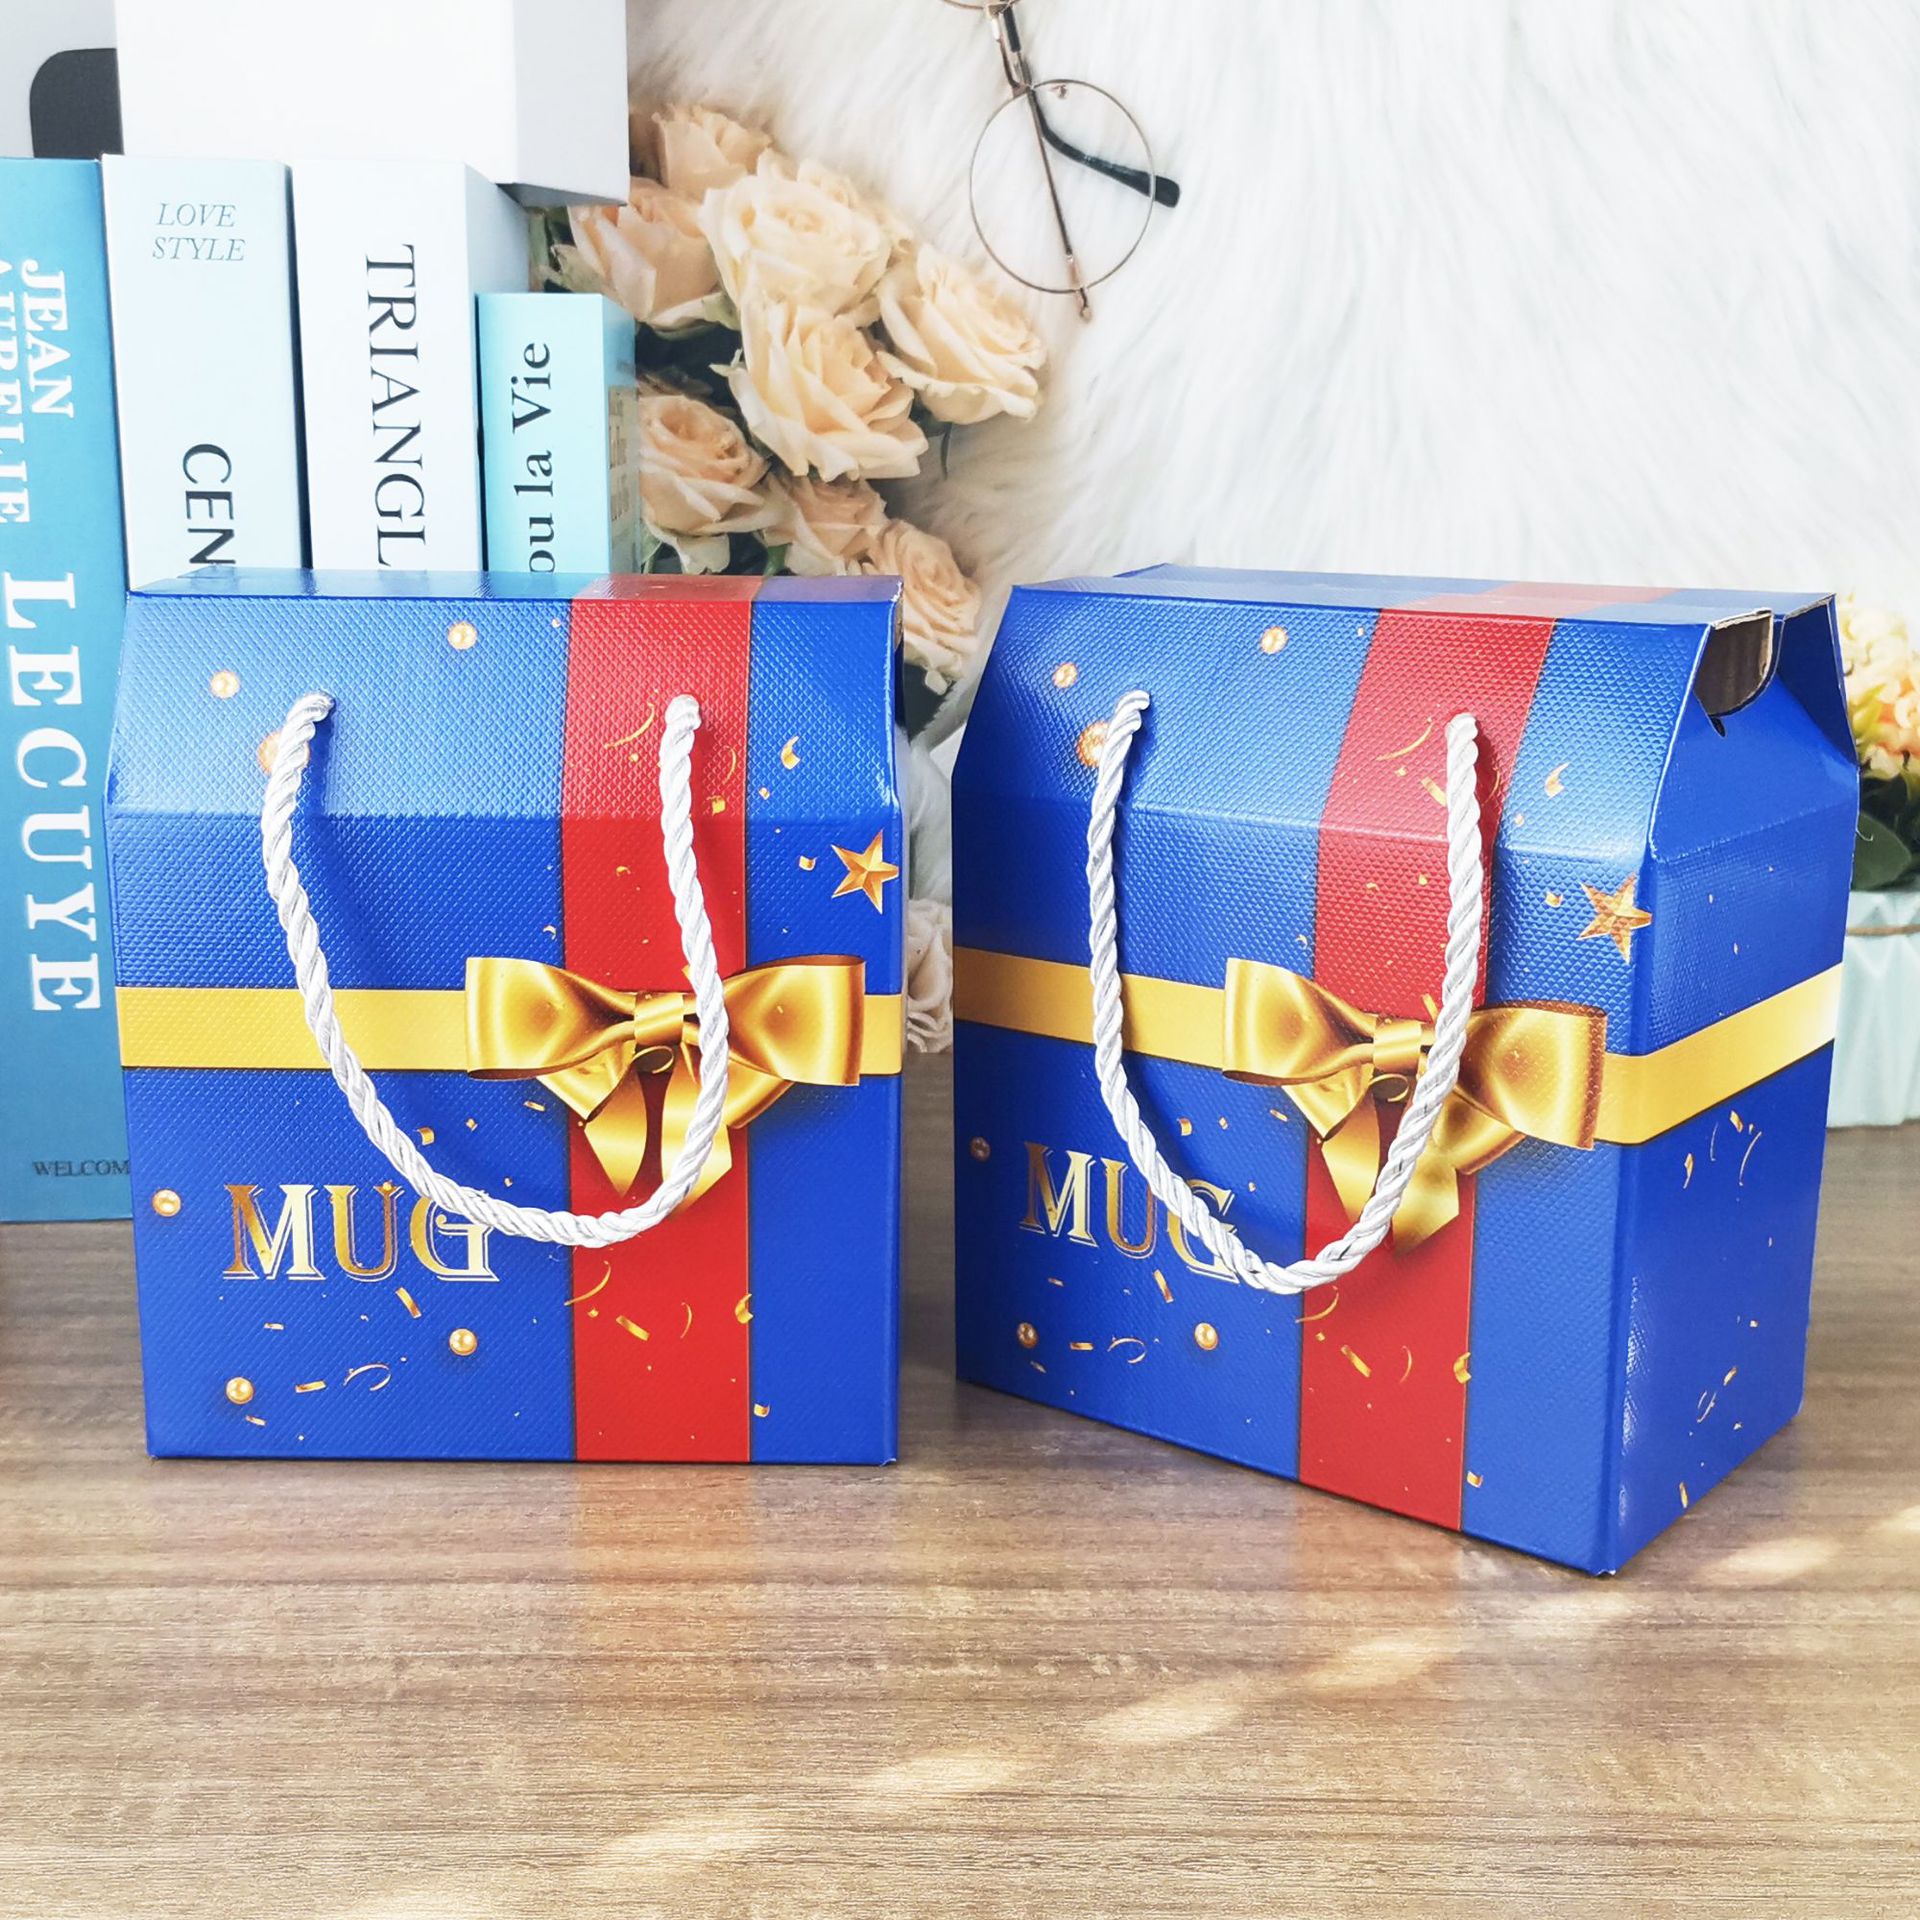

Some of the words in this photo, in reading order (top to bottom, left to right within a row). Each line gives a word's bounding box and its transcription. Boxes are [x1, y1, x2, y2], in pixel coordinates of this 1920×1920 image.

[152, 236, 247, 261] STYLE
[156, 203, 237, 227] LOVE
[21, 258, 75, 419] JEAN
[510, 342, 552, 435] Vie
[0, 258, 31, 524] ELIE
[513, 449, 554, 496] la
[3, 571, 101, 1011] LECUYE
[222, 1183, 501, 1283] MUG
[1018, 1141, 1241, 1284] MUG
